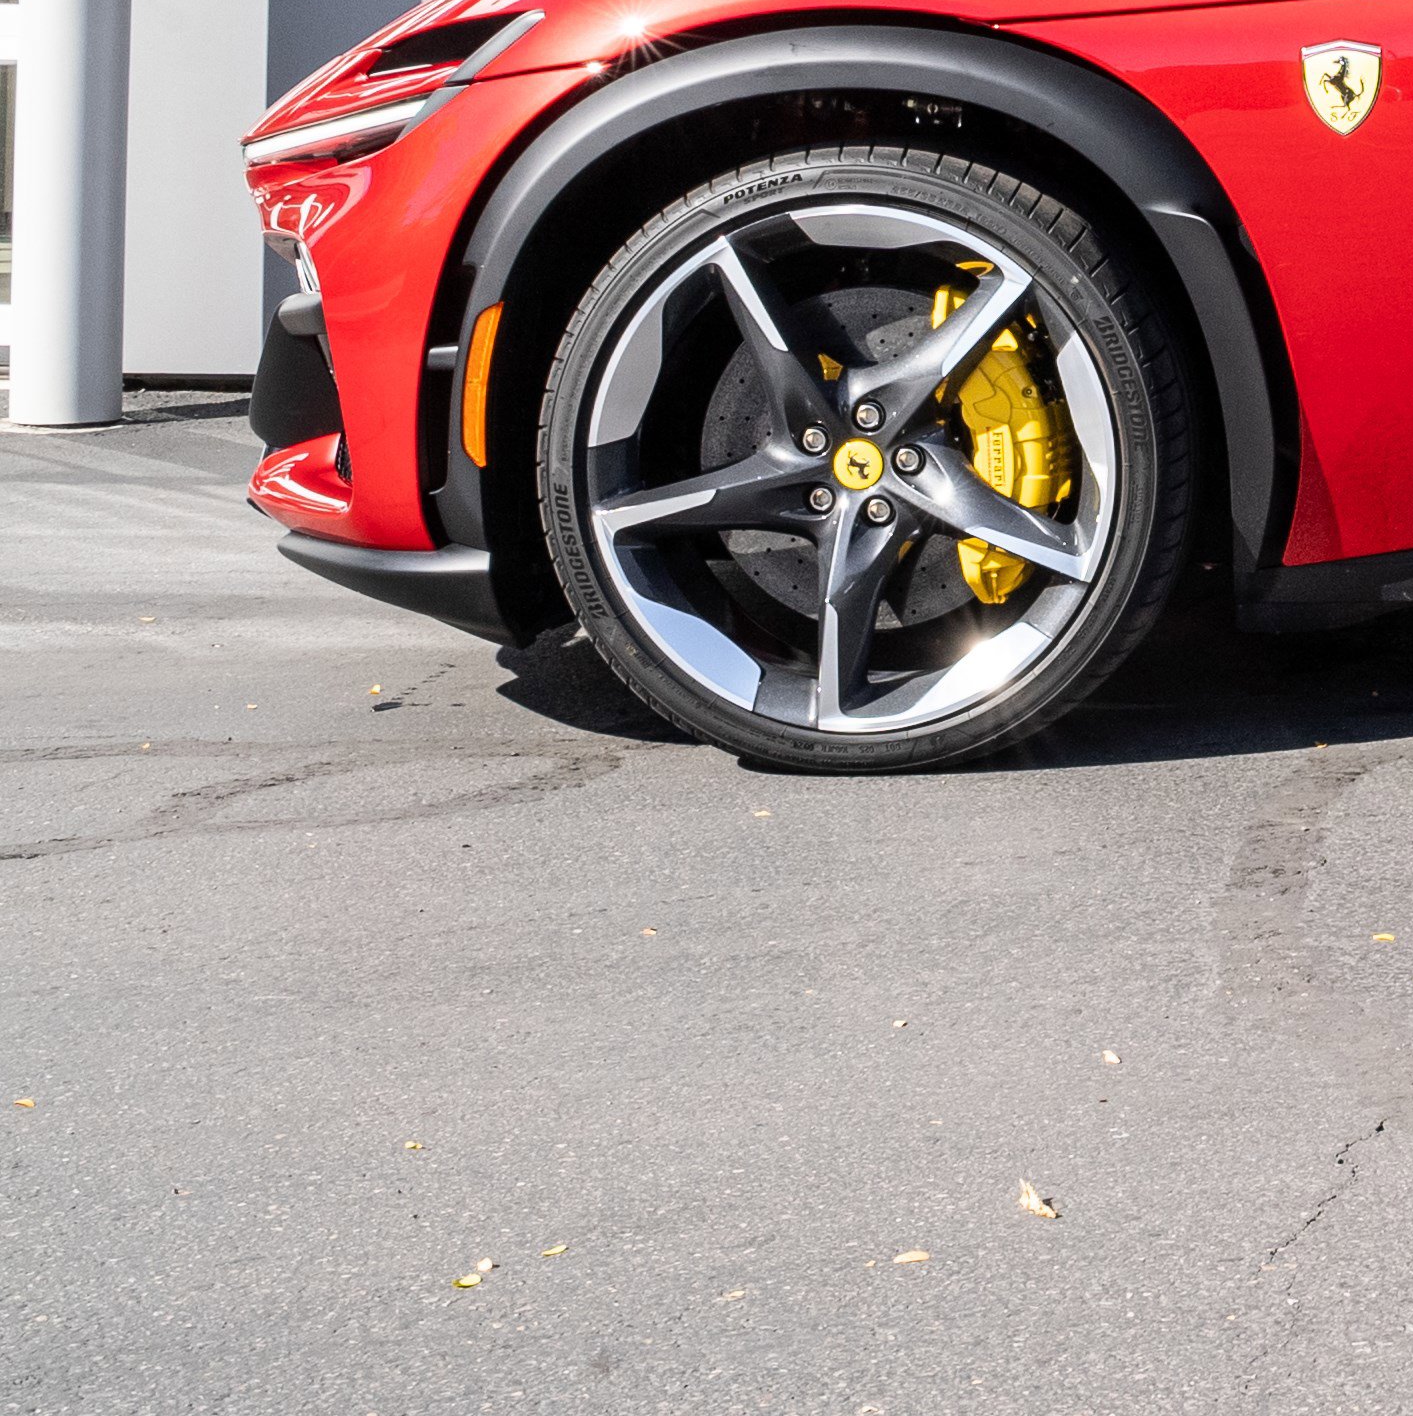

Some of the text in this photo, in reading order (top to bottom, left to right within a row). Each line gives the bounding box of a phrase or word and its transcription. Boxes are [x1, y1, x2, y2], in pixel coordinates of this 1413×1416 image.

[723, 173, 803, 205] POTENZA
[1093, 315, 1149, 452] BRIDGESTONE
[992, 432, 1005, 487] Ferrari
[554, 483, 610, 620] BRIDGESTONE
